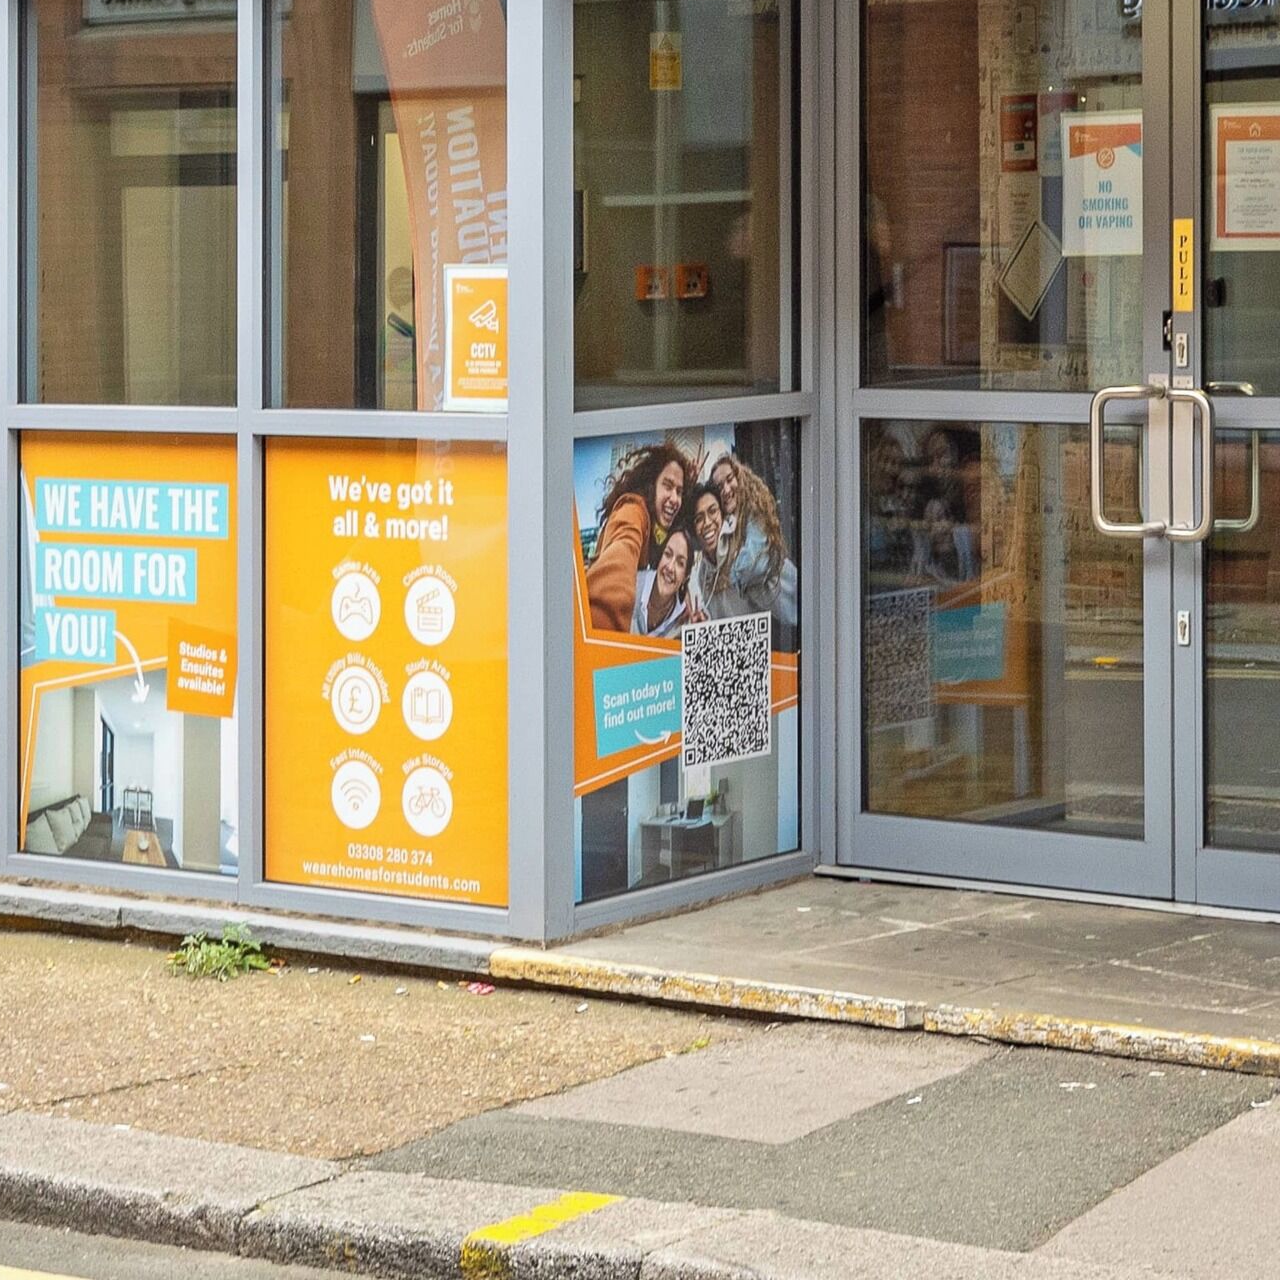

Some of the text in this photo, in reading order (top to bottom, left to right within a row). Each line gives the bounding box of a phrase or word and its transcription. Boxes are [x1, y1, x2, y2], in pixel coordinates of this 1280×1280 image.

[1098, 180, 1112, 194] NO
[1082, 197, 1129, 212] SMOKING
[1078, 214, 1133, 229] OR VAPING
[1179, 235, 1188, 296] PULL
[470, 342, 496, 359] CCTV
[328, 474, 454, 510] We've got it
[43, 483, 220, 533] WE HAVE THE
[333, 509, 448, 541] all & more!
[44, 547, 187, 597] ROOM FOR
[361, 562, 381, 585] Area
[402, 564, 458, 593] Cinema Room
[44, 611, 107, 657] YOU!
[179, 640, 228, 664] Studios &
[346, 651, 366, 667] Bills
[181, 657, 224, 679] Ensuites
[431, 659, 451, 682] Area
[177, 675, 226, 697] available!
[603, 679, 674, 710] Scan today to
[604, 694, 676, 729] find out more!
[421, 752, 454, 782] Storage
[347, 842, 433, 867] 03308 280 374
[303, 860, 481, 893] wearehomesforstudents.com
